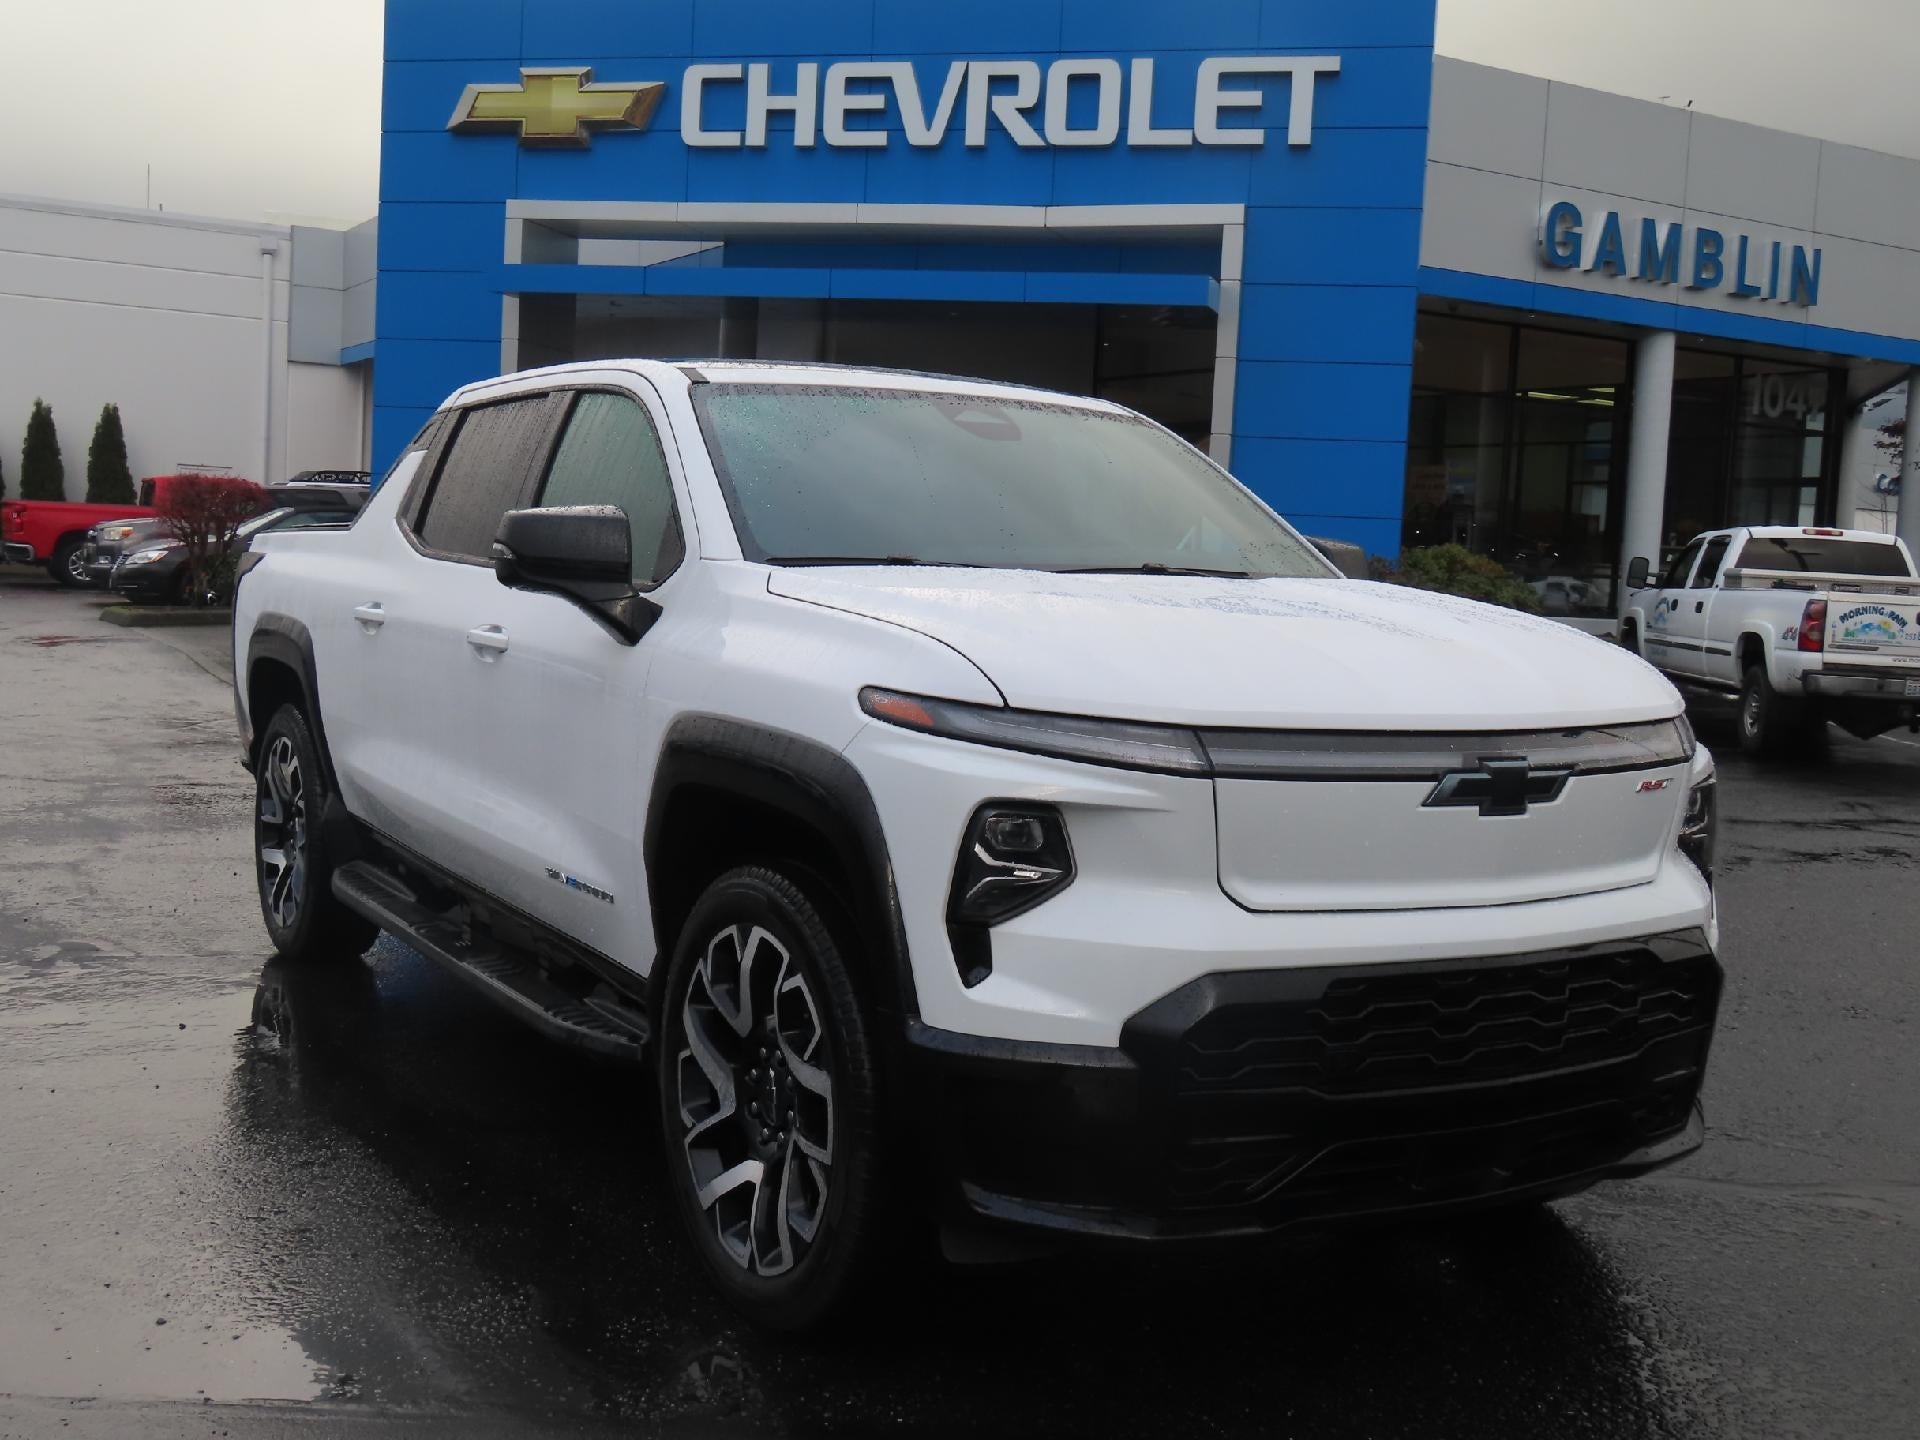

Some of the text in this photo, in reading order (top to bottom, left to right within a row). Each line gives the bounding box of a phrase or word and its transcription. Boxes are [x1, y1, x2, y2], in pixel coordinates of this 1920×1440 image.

[680, 56, 1341, 148] CHEVROLET
[1544, 201, 1822, 307] GAMBLIN
[1839, 606, 1885, 623] MORNING
